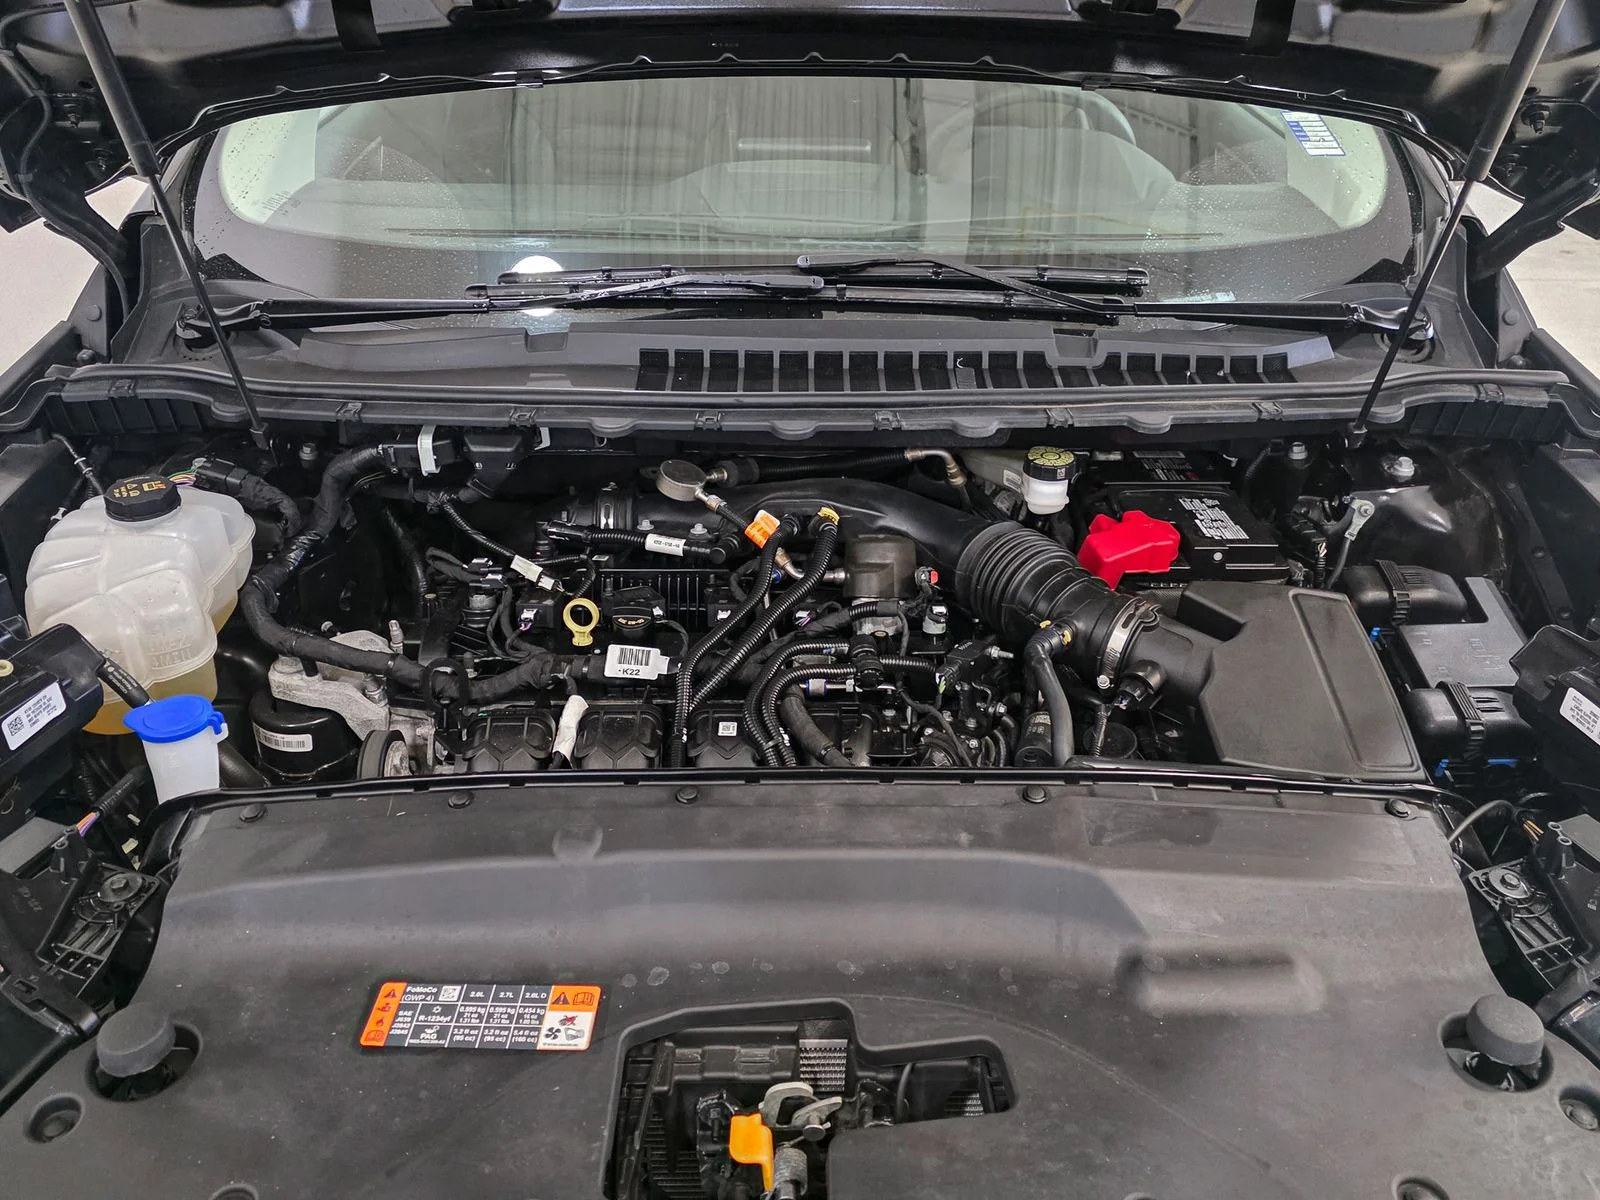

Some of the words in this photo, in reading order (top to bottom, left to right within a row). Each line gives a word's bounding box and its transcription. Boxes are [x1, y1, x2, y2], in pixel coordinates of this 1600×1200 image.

[401, 995, 425, 1003] (GWP
[425, 995, 435, 1003] 4)
[418, 1015, 452, 1023] R-1234yf
